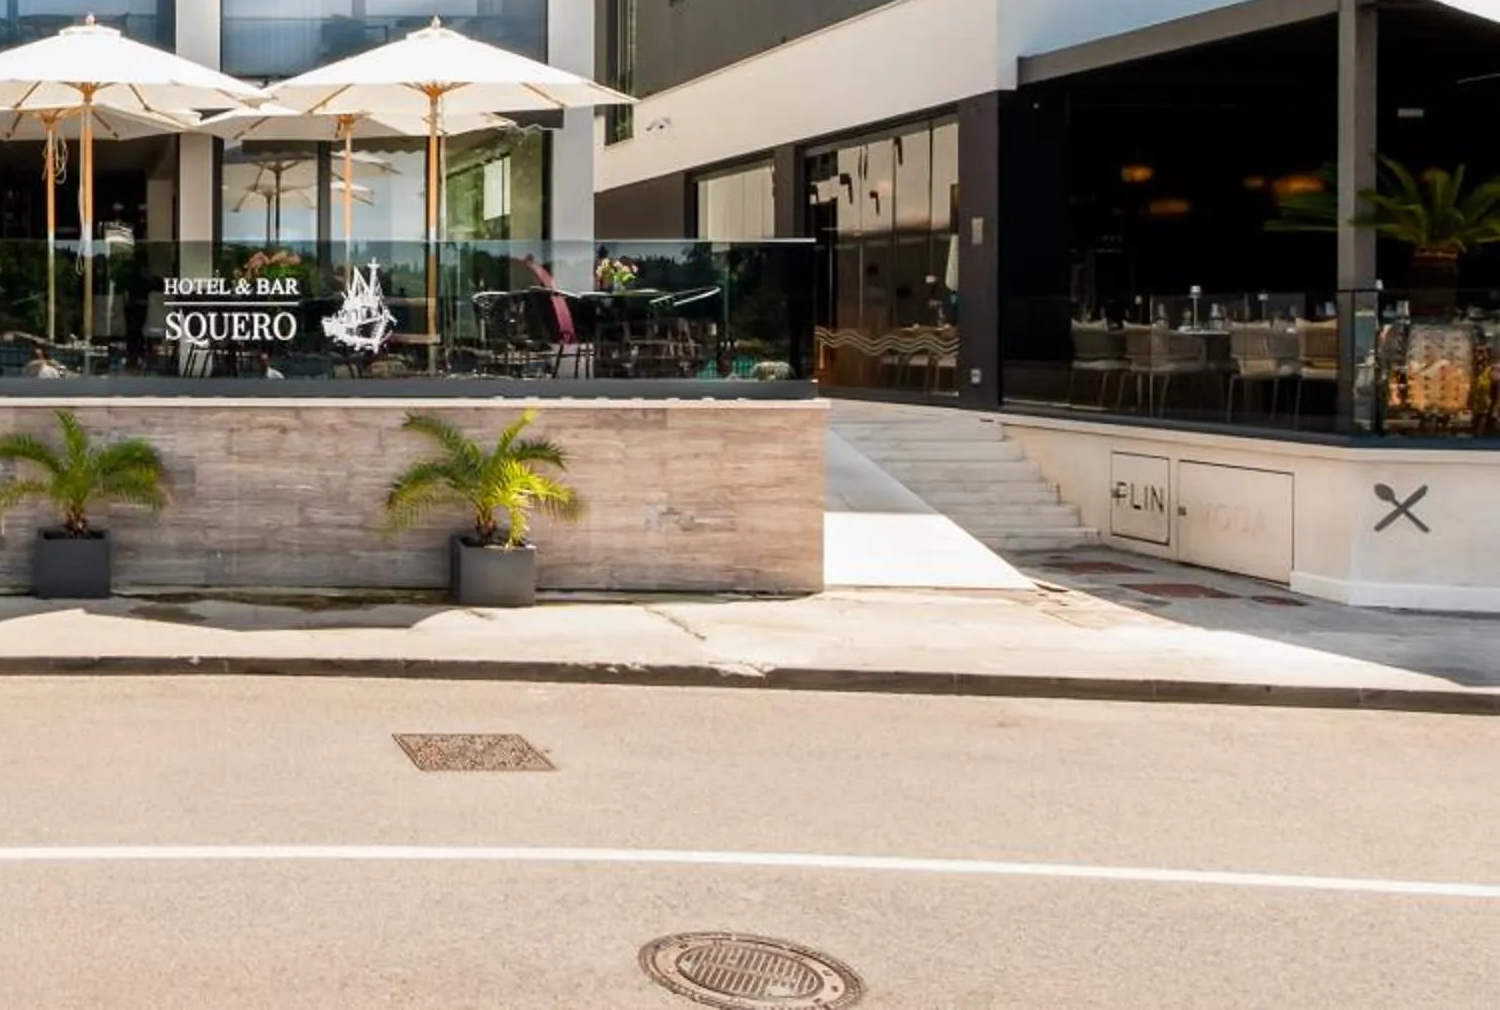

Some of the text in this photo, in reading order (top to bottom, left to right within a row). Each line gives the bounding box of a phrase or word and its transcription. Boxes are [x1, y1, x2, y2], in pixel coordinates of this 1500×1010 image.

[163, 277, 299, 295] HOTEL & BAR
[164, 311, 298, 347] SQUERO
